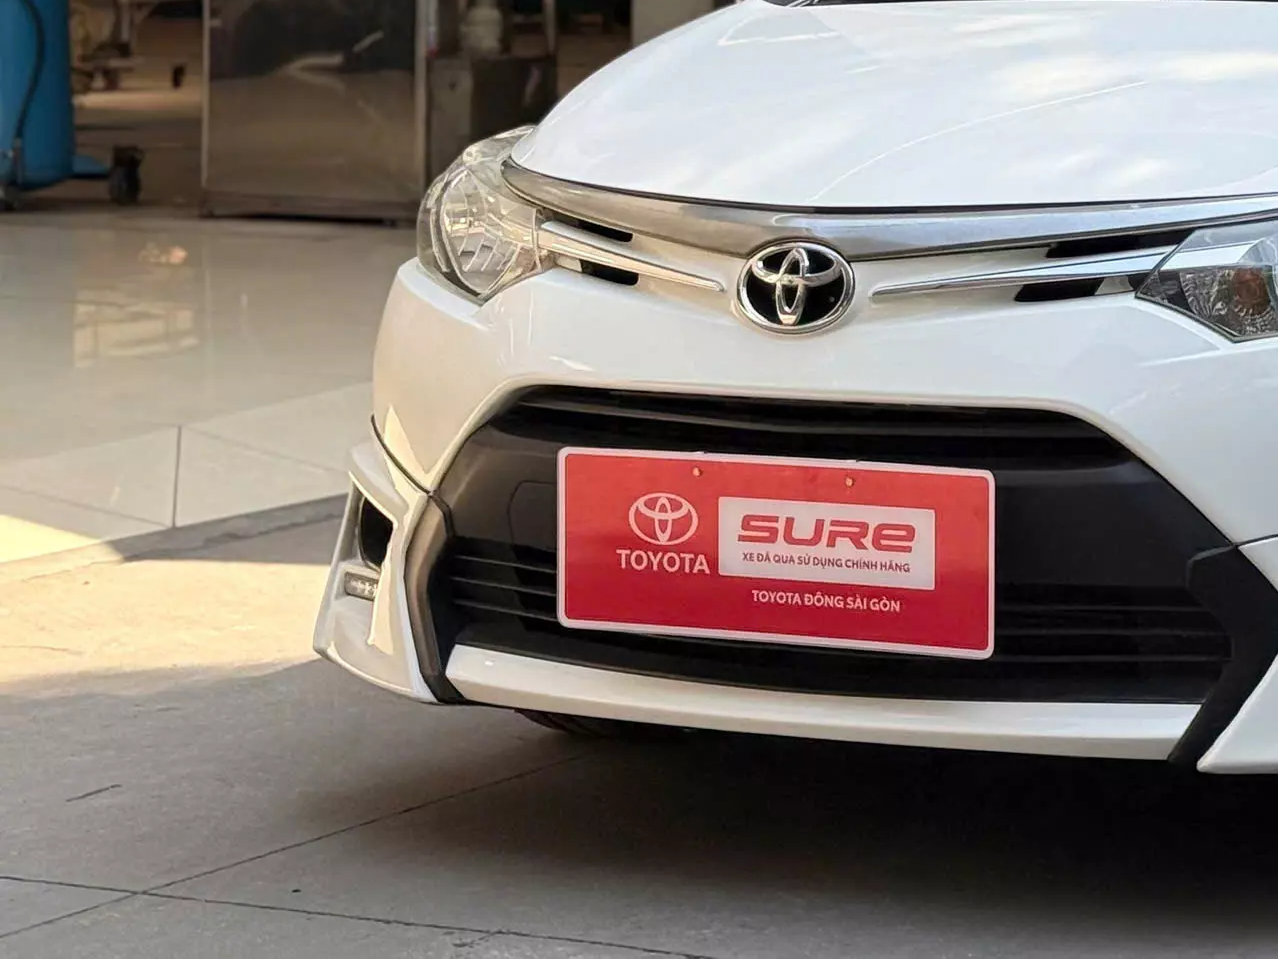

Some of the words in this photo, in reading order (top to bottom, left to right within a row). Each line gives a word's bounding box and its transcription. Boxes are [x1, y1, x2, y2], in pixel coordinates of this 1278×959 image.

[616, 549, 710, 575] TOYOTA
[742, 552, 755, 562] XE
[773, 553, 796, 566] QUA
[812, 556, 843, 569] DỤNG
[752, 590, 802, 606] TOYOTA
[804, 592, 844, 609] ĐÔNG
[846, 594, 867, 610] SÀI
[869, 596, 900, 612] GÒN
